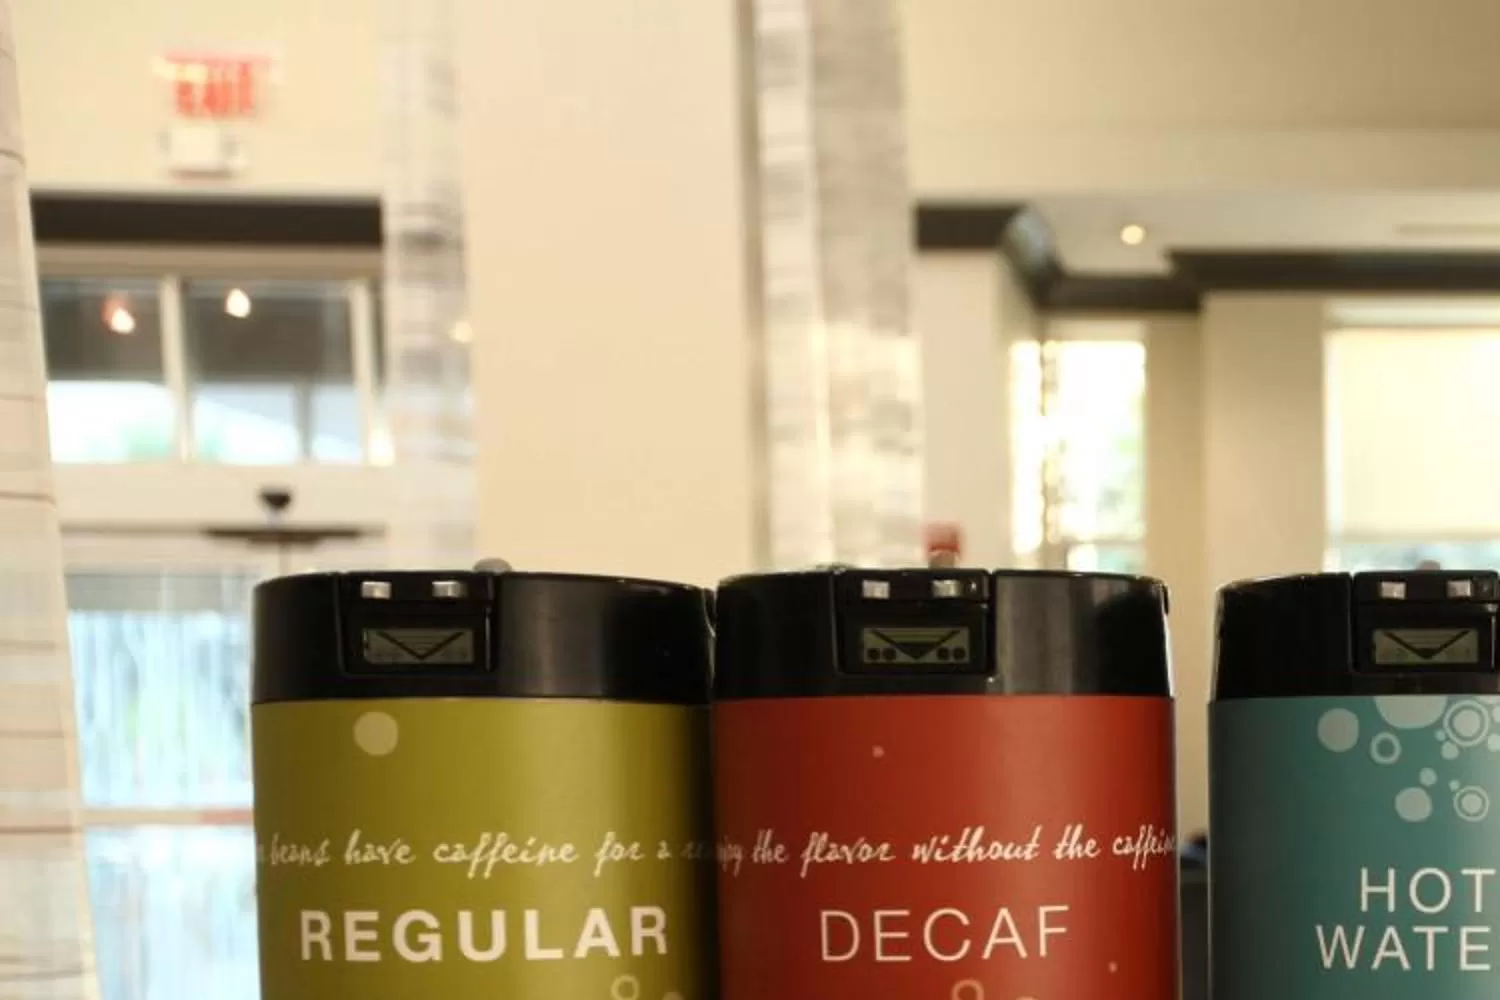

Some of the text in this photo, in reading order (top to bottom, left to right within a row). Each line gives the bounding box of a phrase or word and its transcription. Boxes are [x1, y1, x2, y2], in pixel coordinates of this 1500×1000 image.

[344, 828, 416, 866] have
[433, 832, 579, 878] caffeine
[592, 832, 645, 876] for
[656, 839, 673, 860] a
[751, 828, 790, 864] the
[800, 832, 896, 878] flavor
[912, 825, 1040, 864] without
[1053, 823, 1102, 860] the
[1360, 866, 1497, 914] HOT
[300, 905, 669, 963] REGULAR
[819, 904, 1070, 963] DECAF
